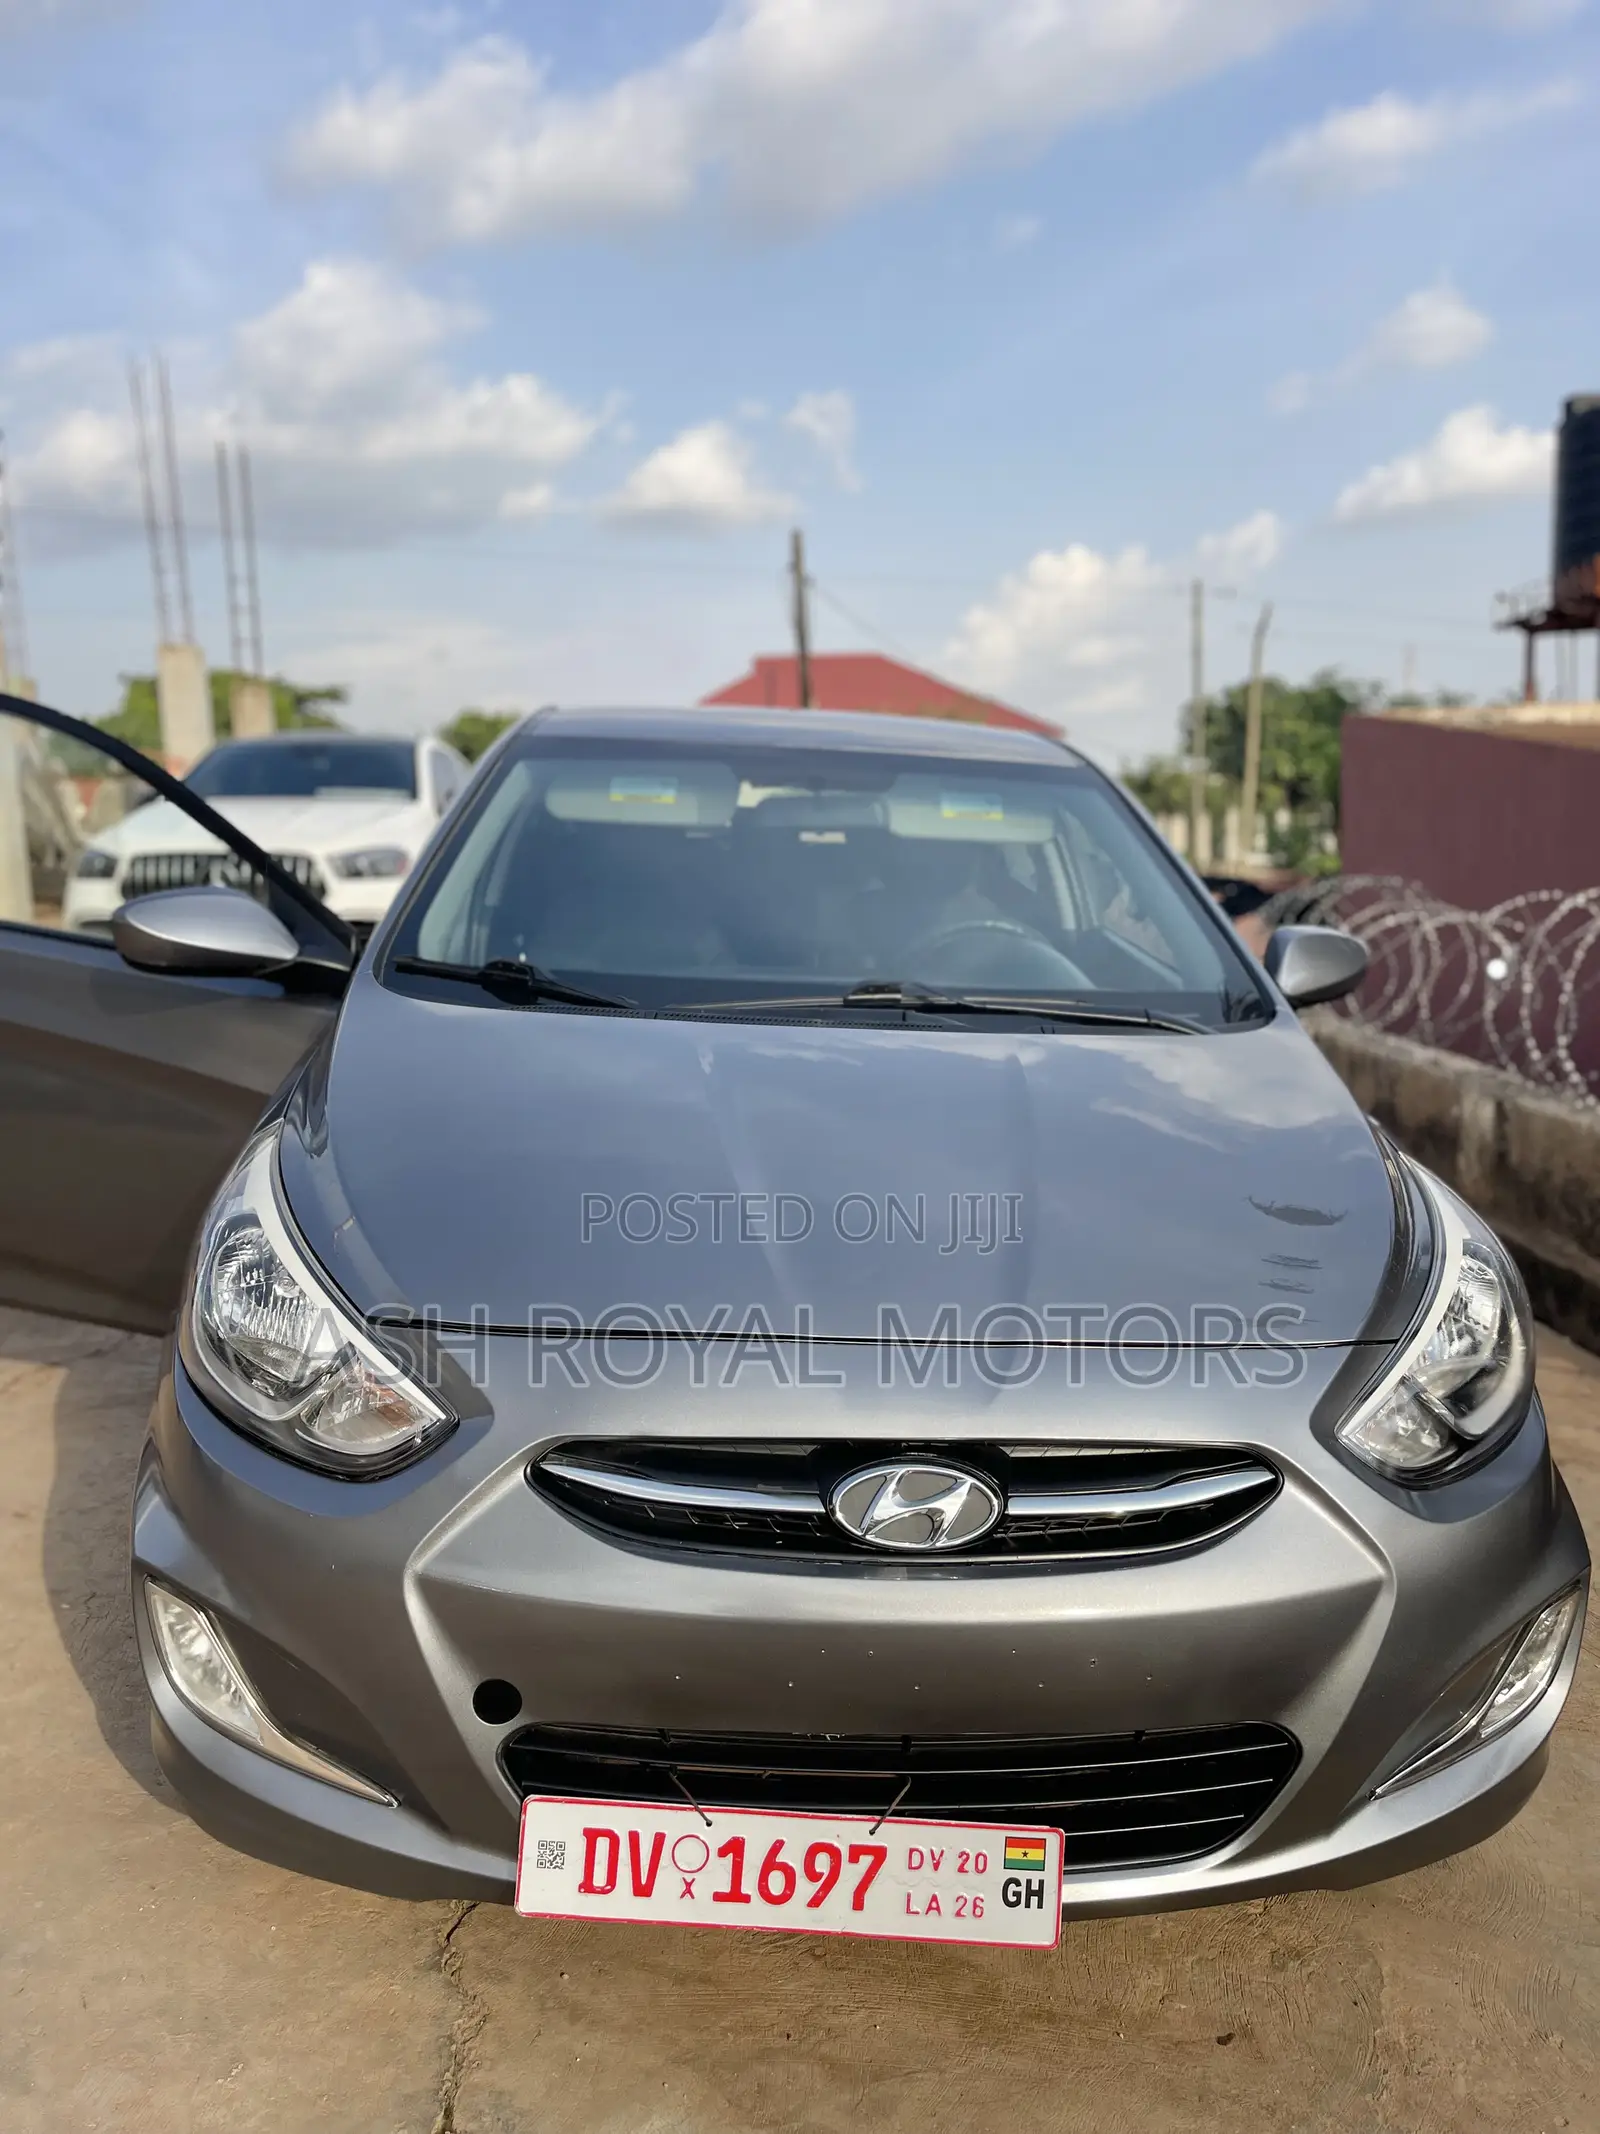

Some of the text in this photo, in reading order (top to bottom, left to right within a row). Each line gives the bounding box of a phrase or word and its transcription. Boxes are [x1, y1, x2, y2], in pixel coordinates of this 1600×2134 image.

[577, 1826, 889, 1912] DV 1697
[907, 1846, 989, 1875] DV 20
[905, 1890, 986, 1919] LA 26
[1001, 1876, 1045, 1910] GH
